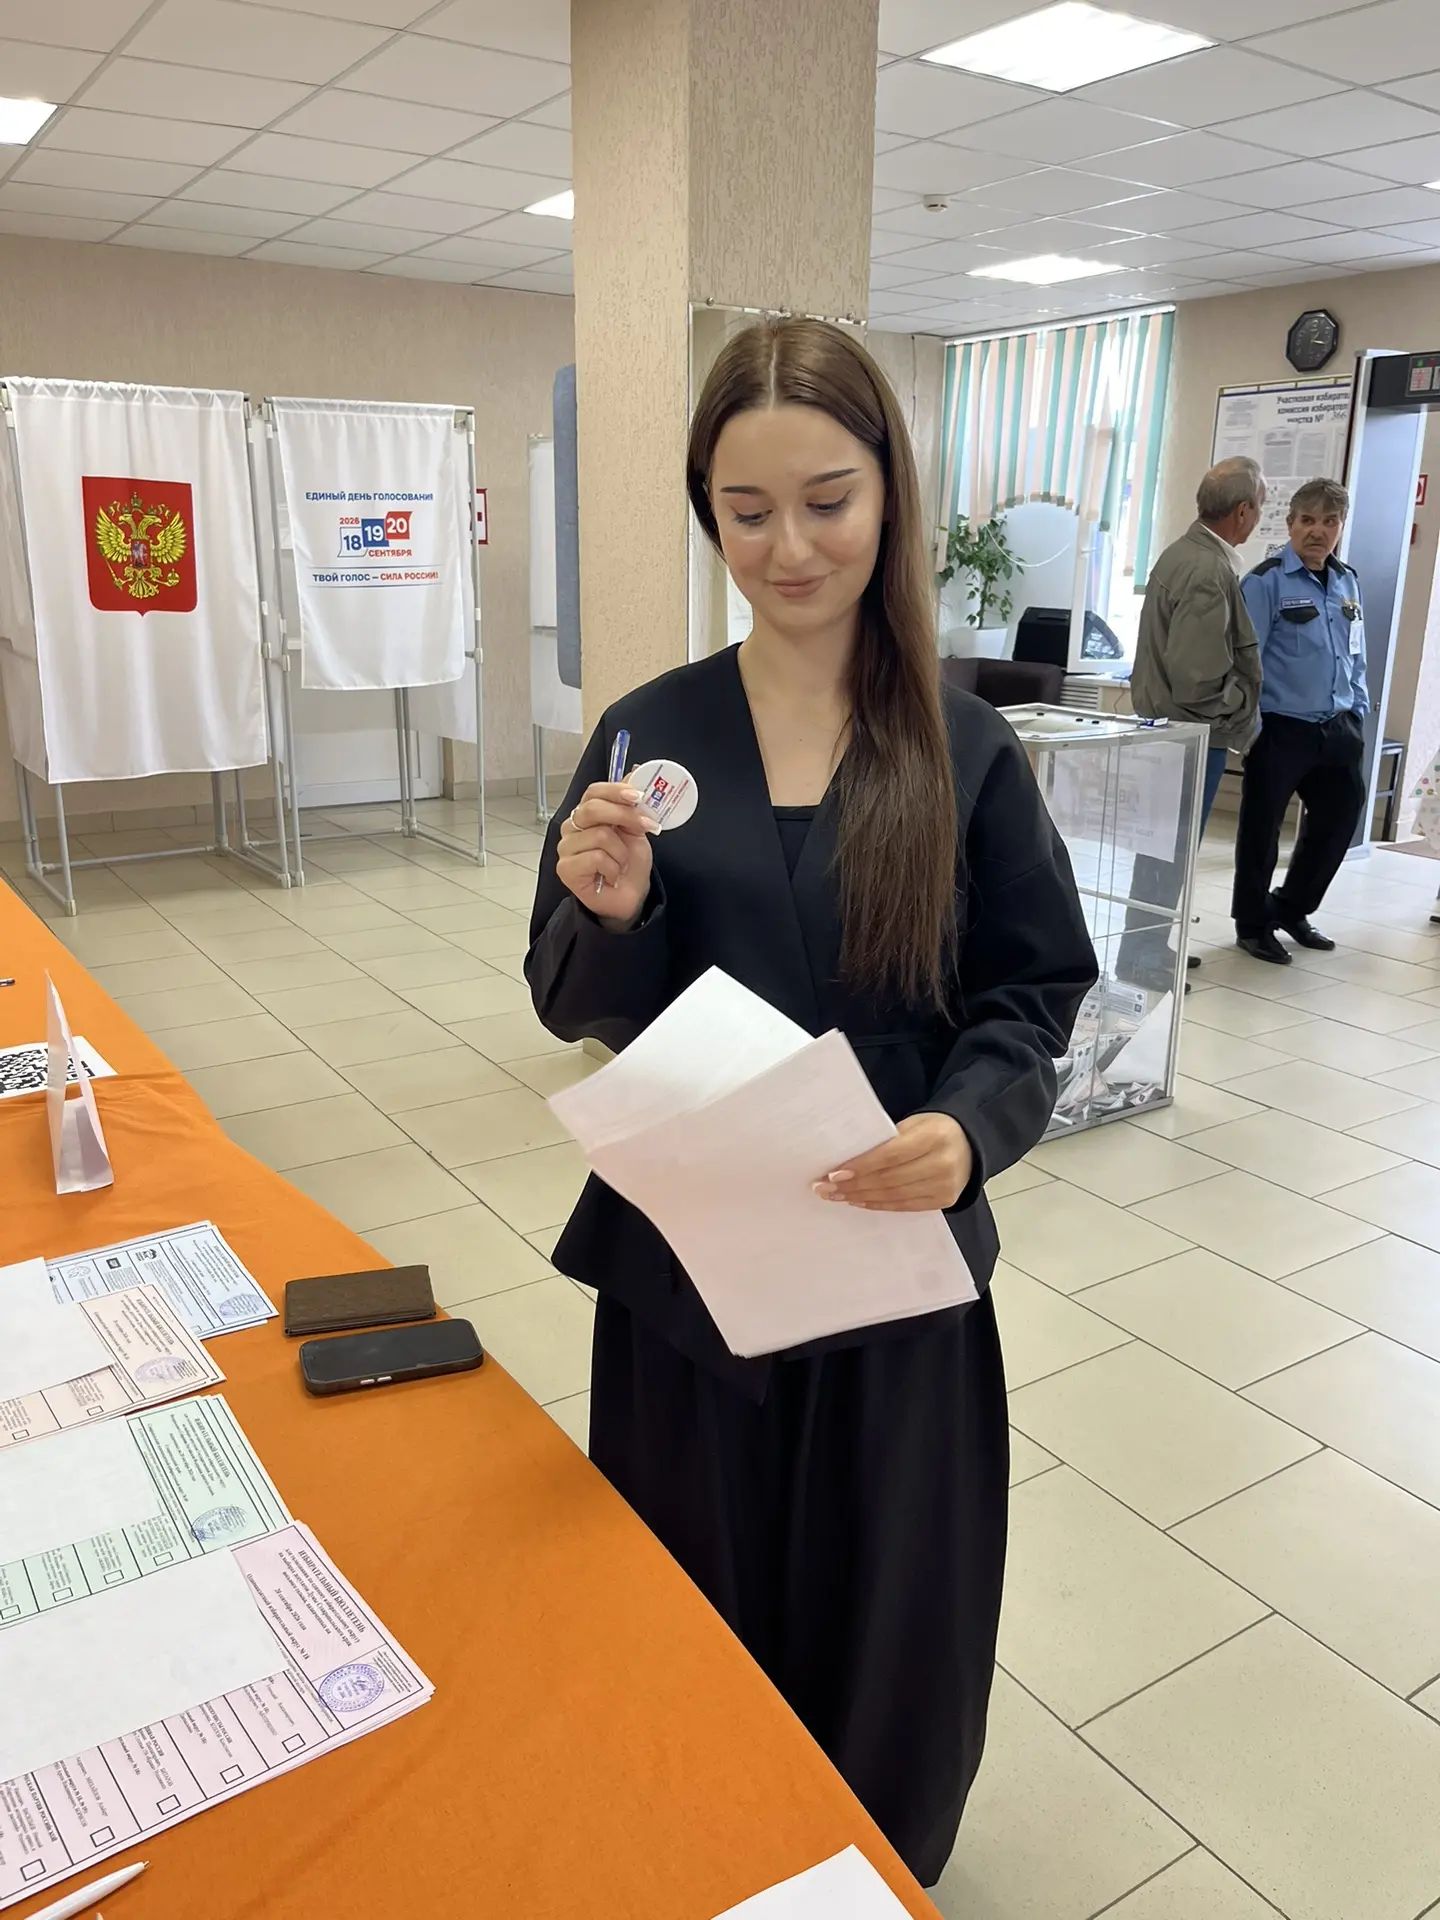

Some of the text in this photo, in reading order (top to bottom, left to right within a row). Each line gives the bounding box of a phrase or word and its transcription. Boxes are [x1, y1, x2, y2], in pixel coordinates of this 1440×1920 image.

[305, 491, 346, 501] ЕДИНЫЙ
[348, 493, 372, 502] ДЕНЬ
[339, 517, 360, 525] 2026
[343, 517, 408, 550] 18 19 20
[368, 549, 412, 557] СЕНТЯБРЯ
[312, 572, 338, 582] ТВОЙ
[340, 574, 370, 582] ГОЛОС
[380, 572, 403, 581] СИЛА
[404, 571, 439, 580] РОССИИ!
[334, 1595, 365, 1632] БЮЛЛЕТЕНЬ
